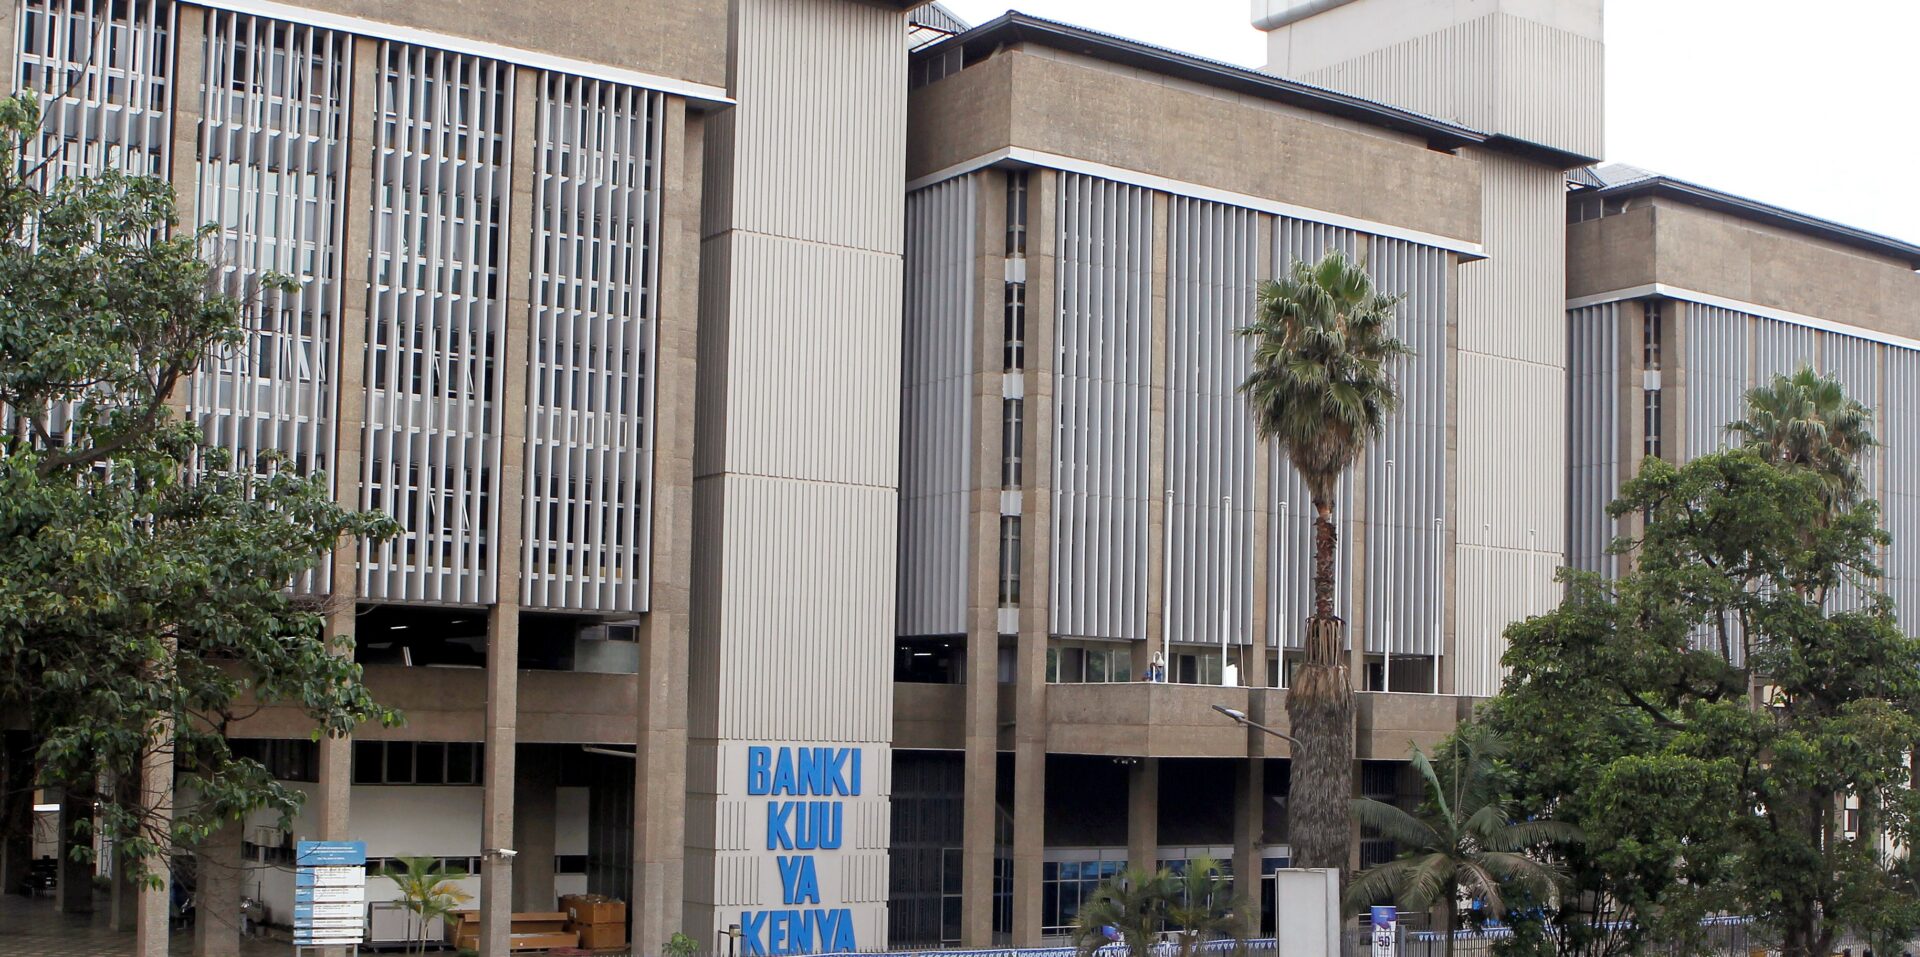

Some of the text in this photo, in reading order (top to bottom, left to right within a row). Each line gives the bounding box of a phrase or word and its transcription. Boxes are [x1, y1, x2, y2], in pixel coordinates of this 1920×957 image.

[748, 746, 862, 796] BANKI
[767, 801, 843, 850] KUU
[777, 855, 821, 905] YA
[741, 908, 857, 956] KENYA
[1378, 936, 1390, 947] 50
